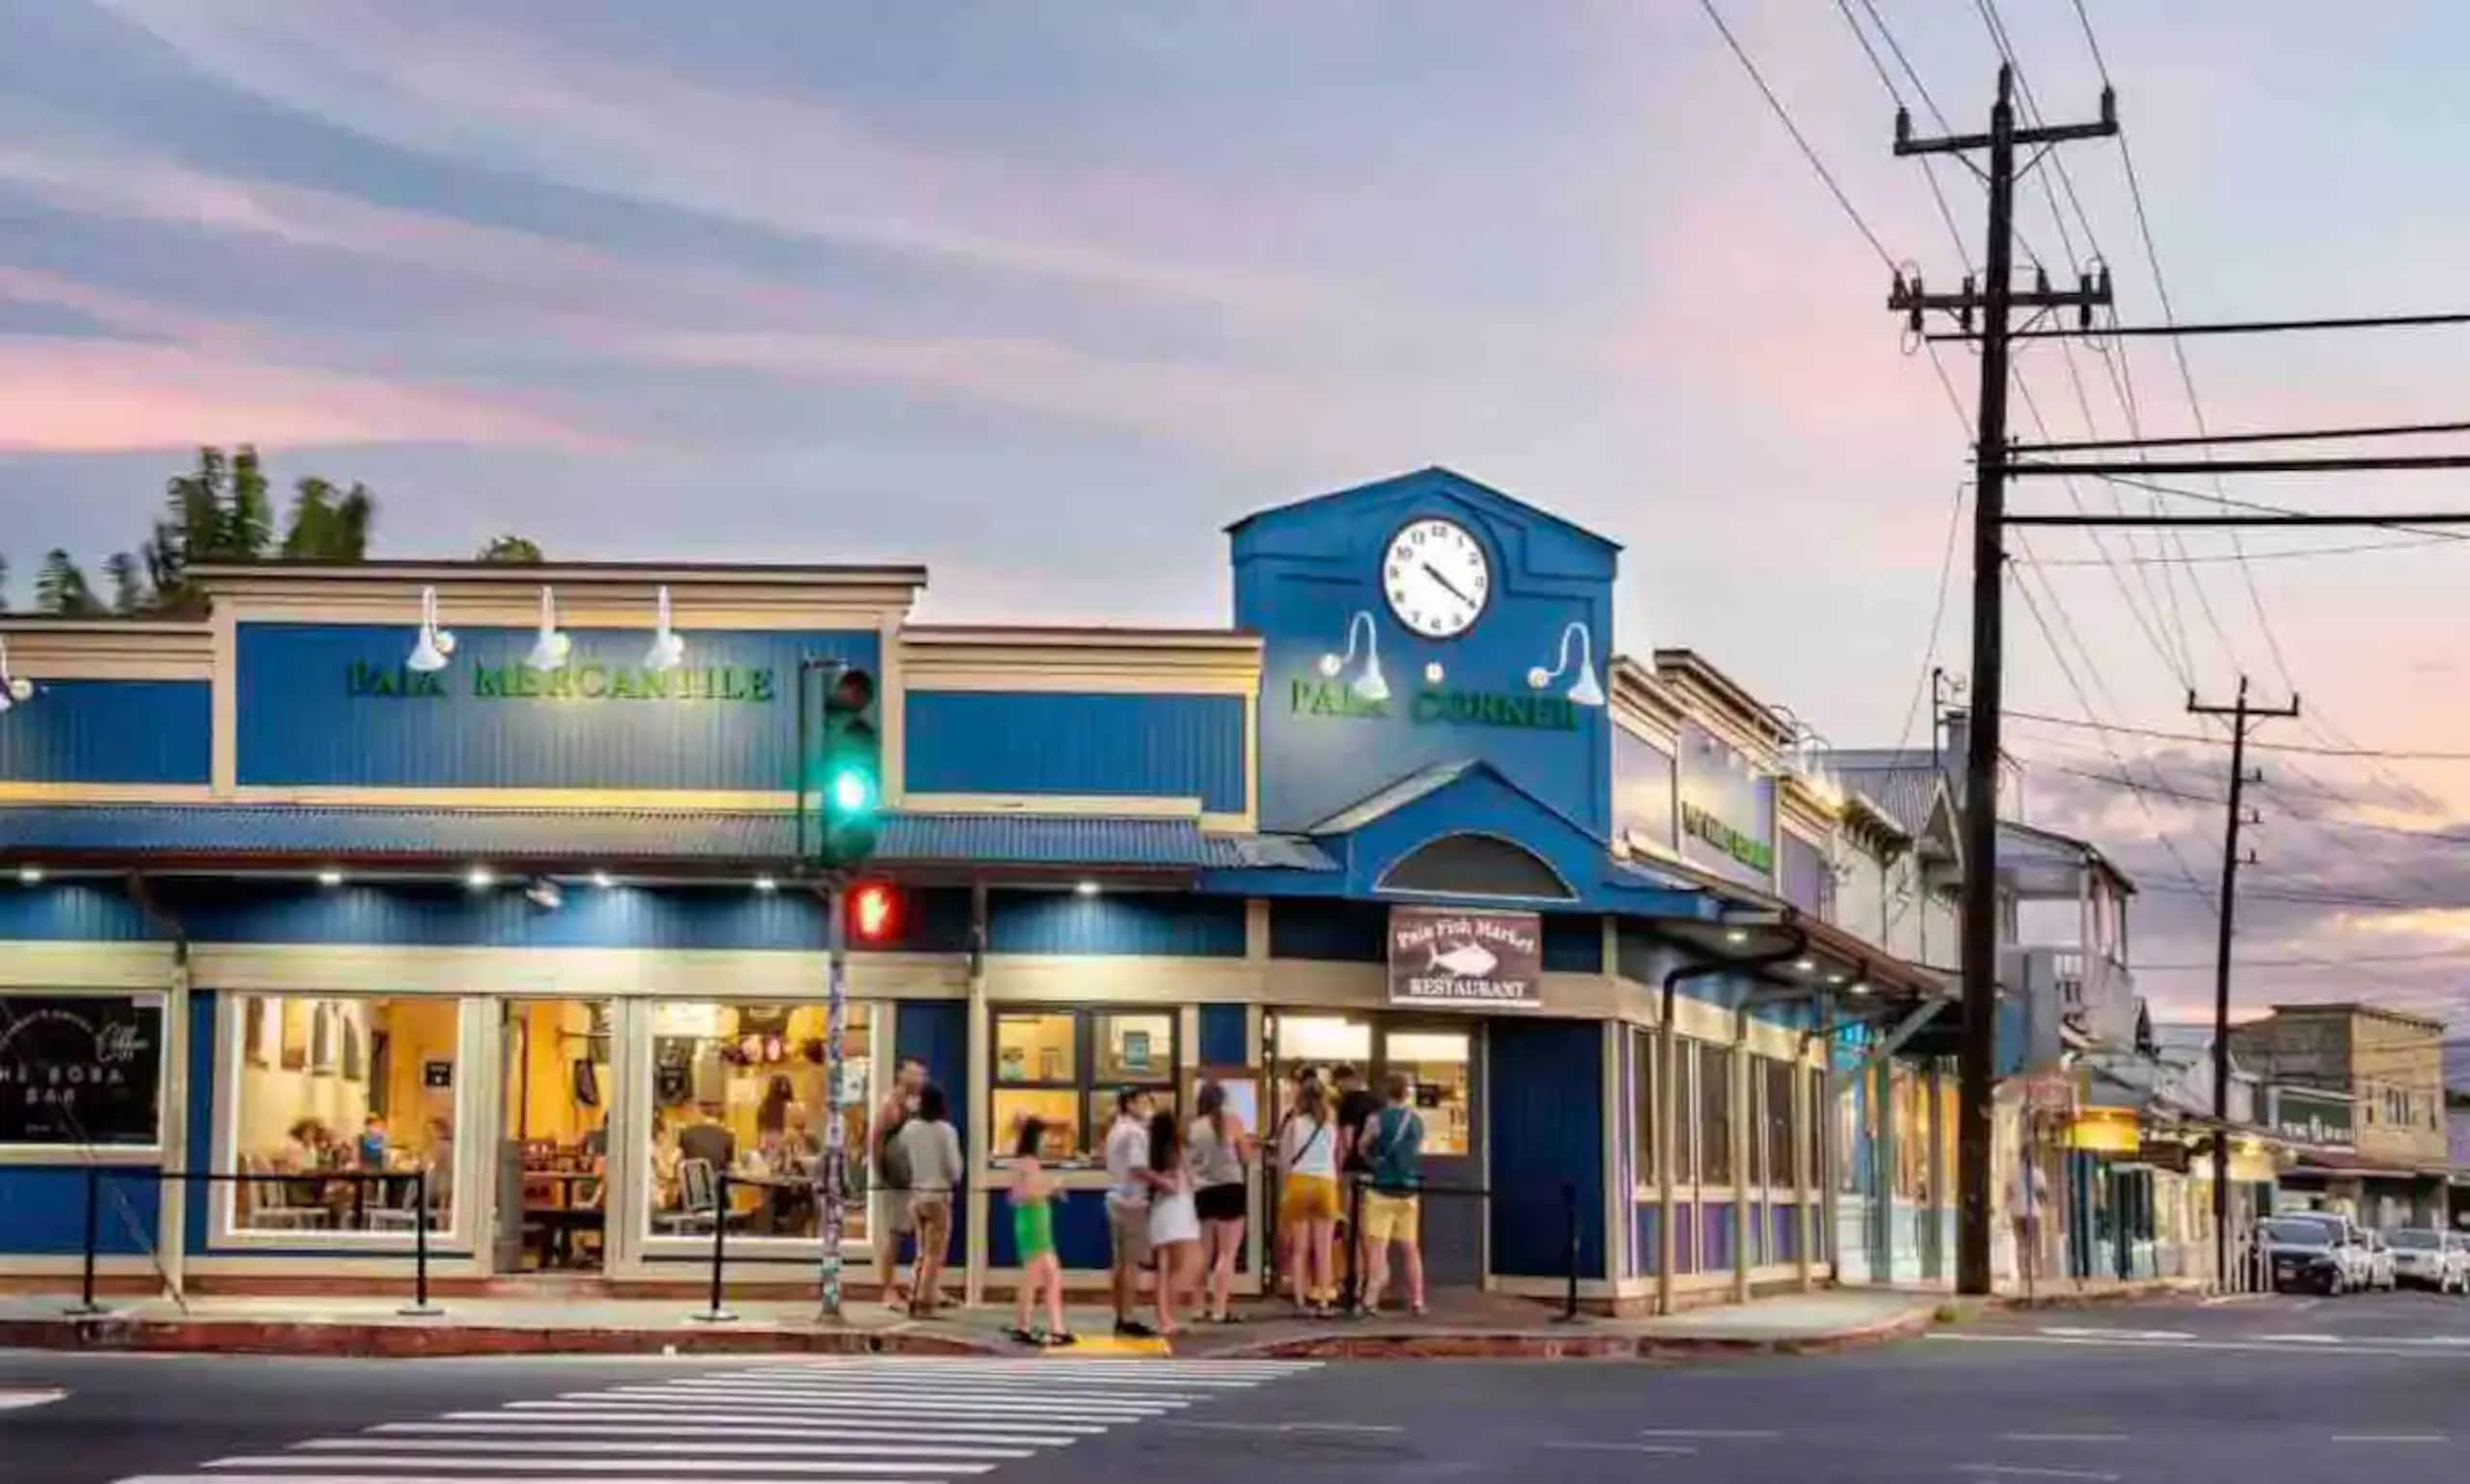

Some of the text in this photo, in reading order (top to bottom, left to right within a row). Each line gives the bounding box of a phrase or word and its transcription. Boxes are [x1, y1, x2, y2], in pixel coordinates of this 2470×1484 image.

[1436, 918, 1472, 936] Fish
[1474, 919, 1535, 953] Market
[1409, 976, 1526, 997] RESTAURANT
